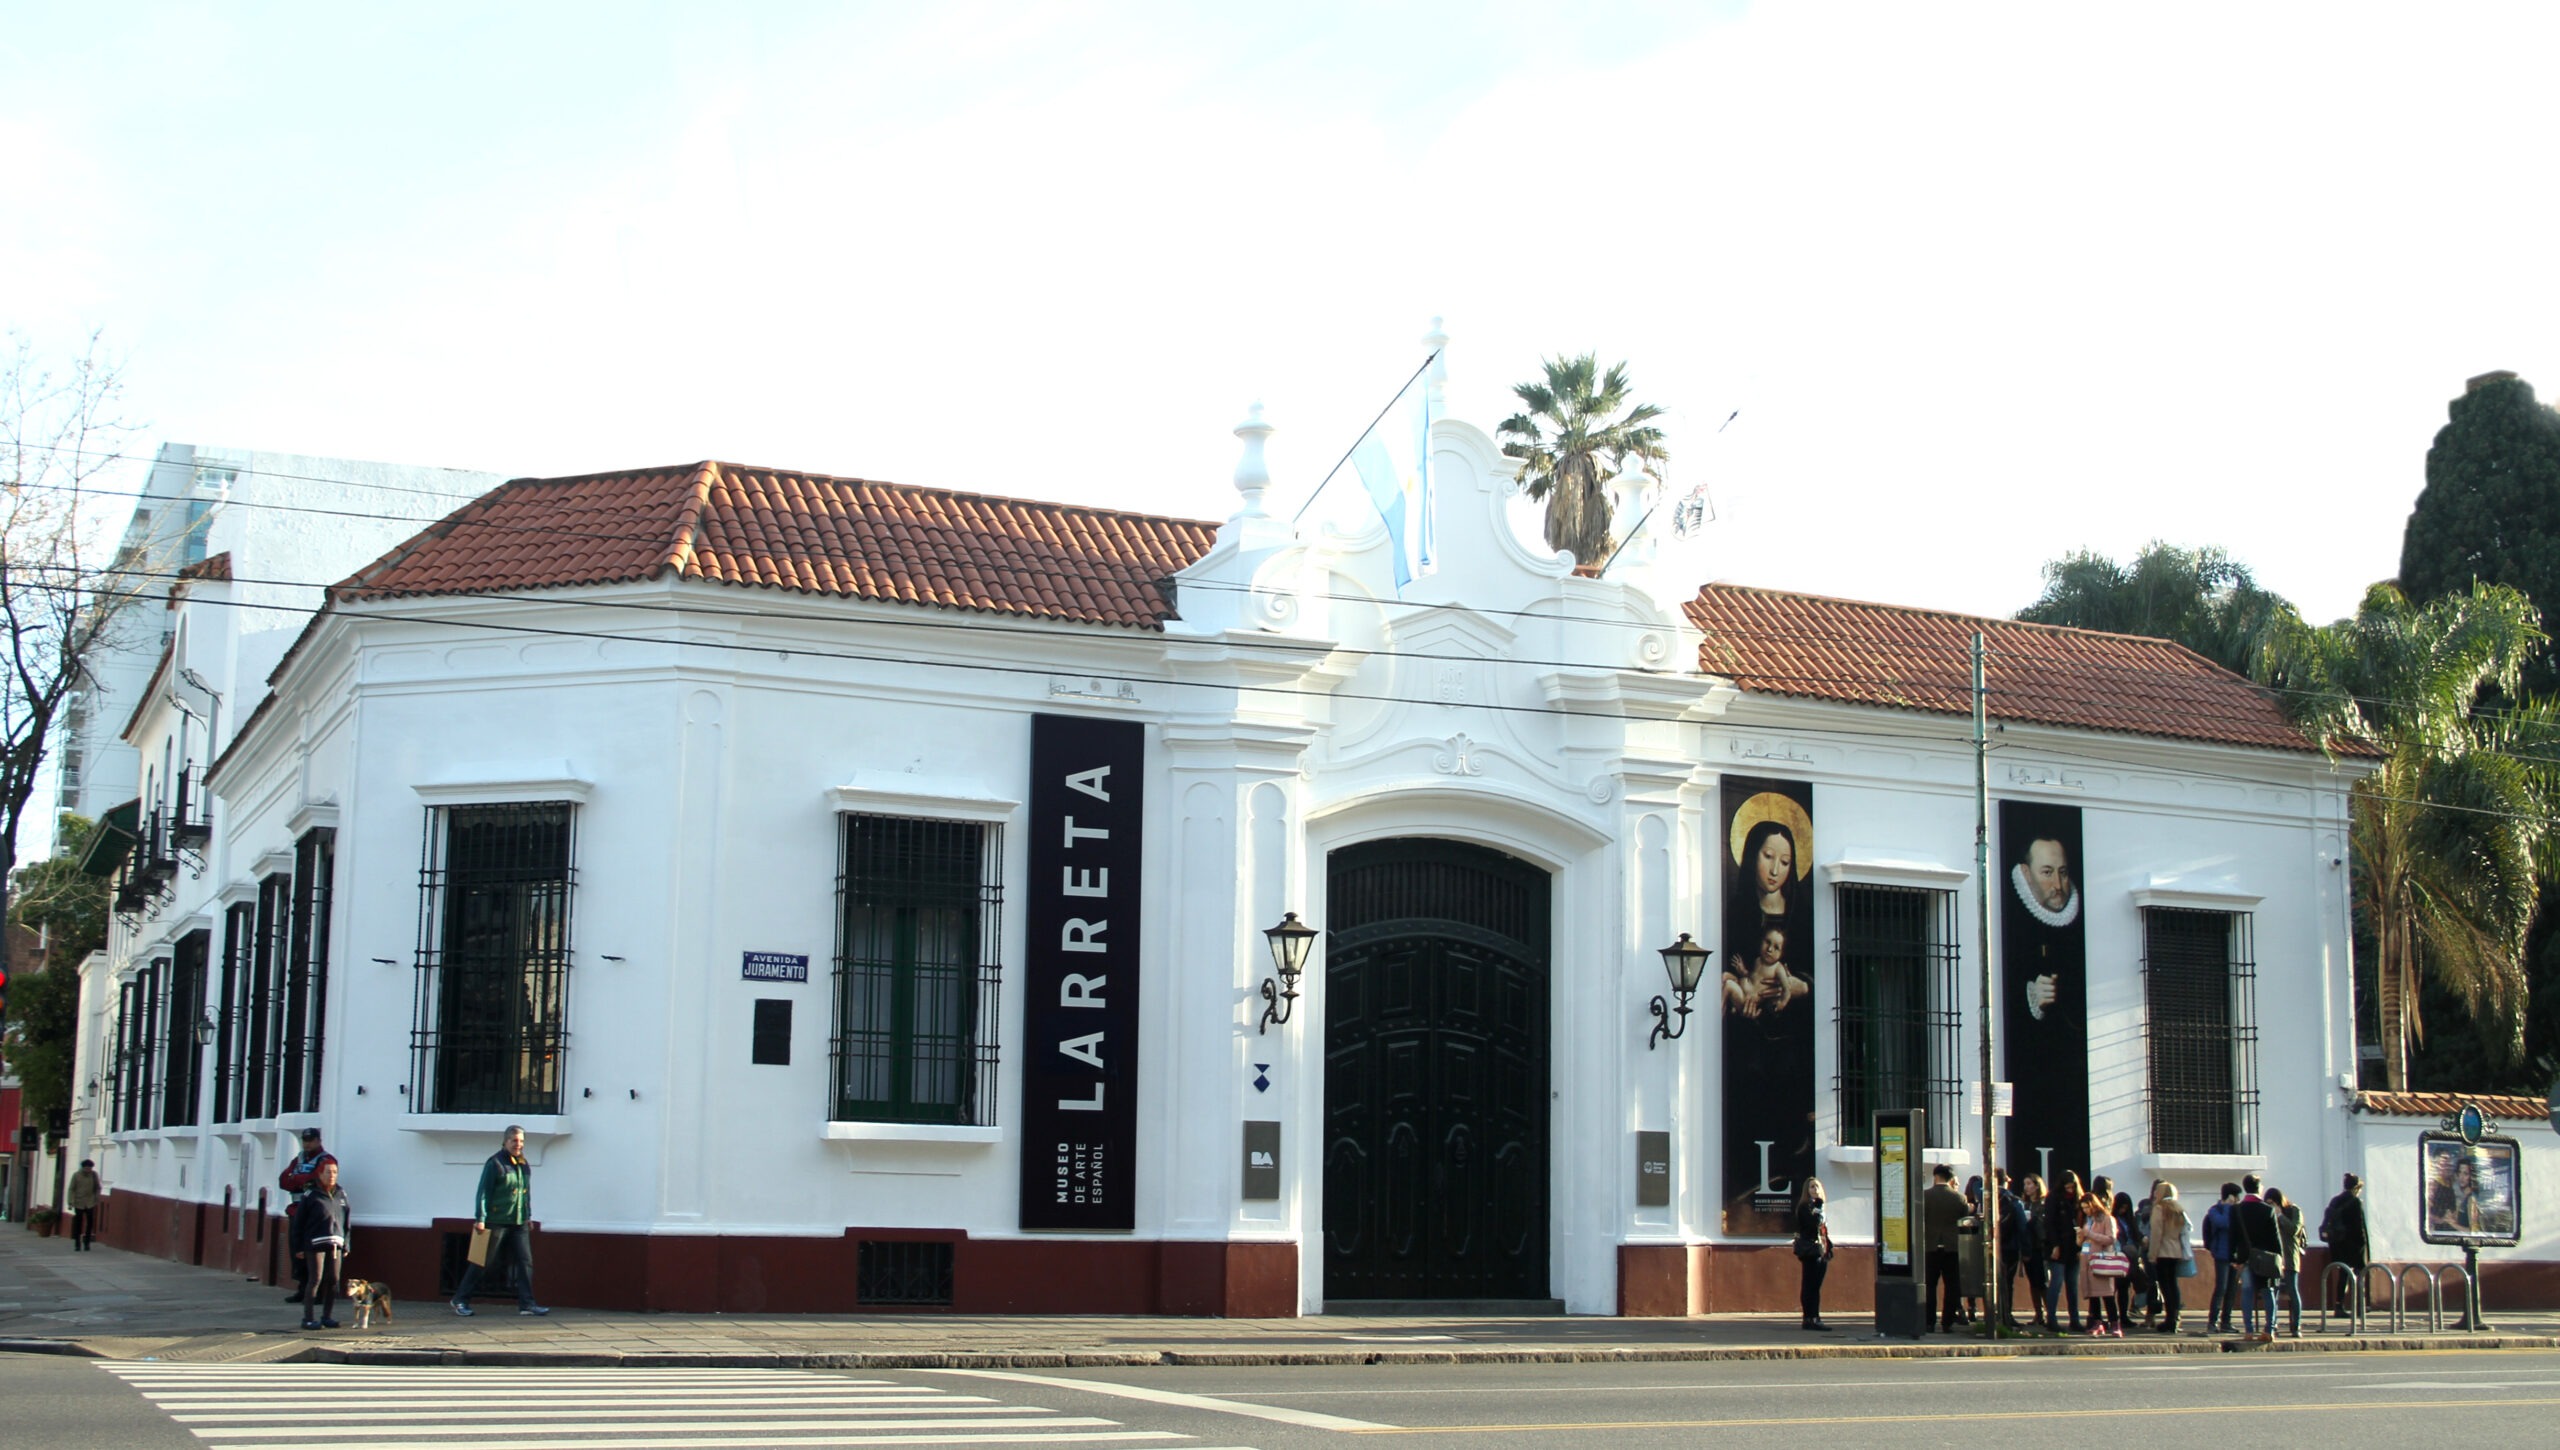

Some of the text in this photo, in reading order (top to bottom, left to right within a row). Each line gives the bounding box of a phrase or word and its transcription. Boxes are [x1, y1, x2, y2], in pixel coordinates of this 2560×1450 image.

[752, 954, 798, 965] AVENIDA
[1058, 765, 1110, 1111] LARRETA
[744, 962, 806, 979] JURAMENTO
[1056, 1142, 1069, 1203] MUSEO
[1074, 1143, 1087, 1203] DE ARTE
[1091, 1143, 1104, 1204] ESPAÑOL
[1251, 1151, 1274, 1166] BA
[1754, 1140, 1792, 1195] L
